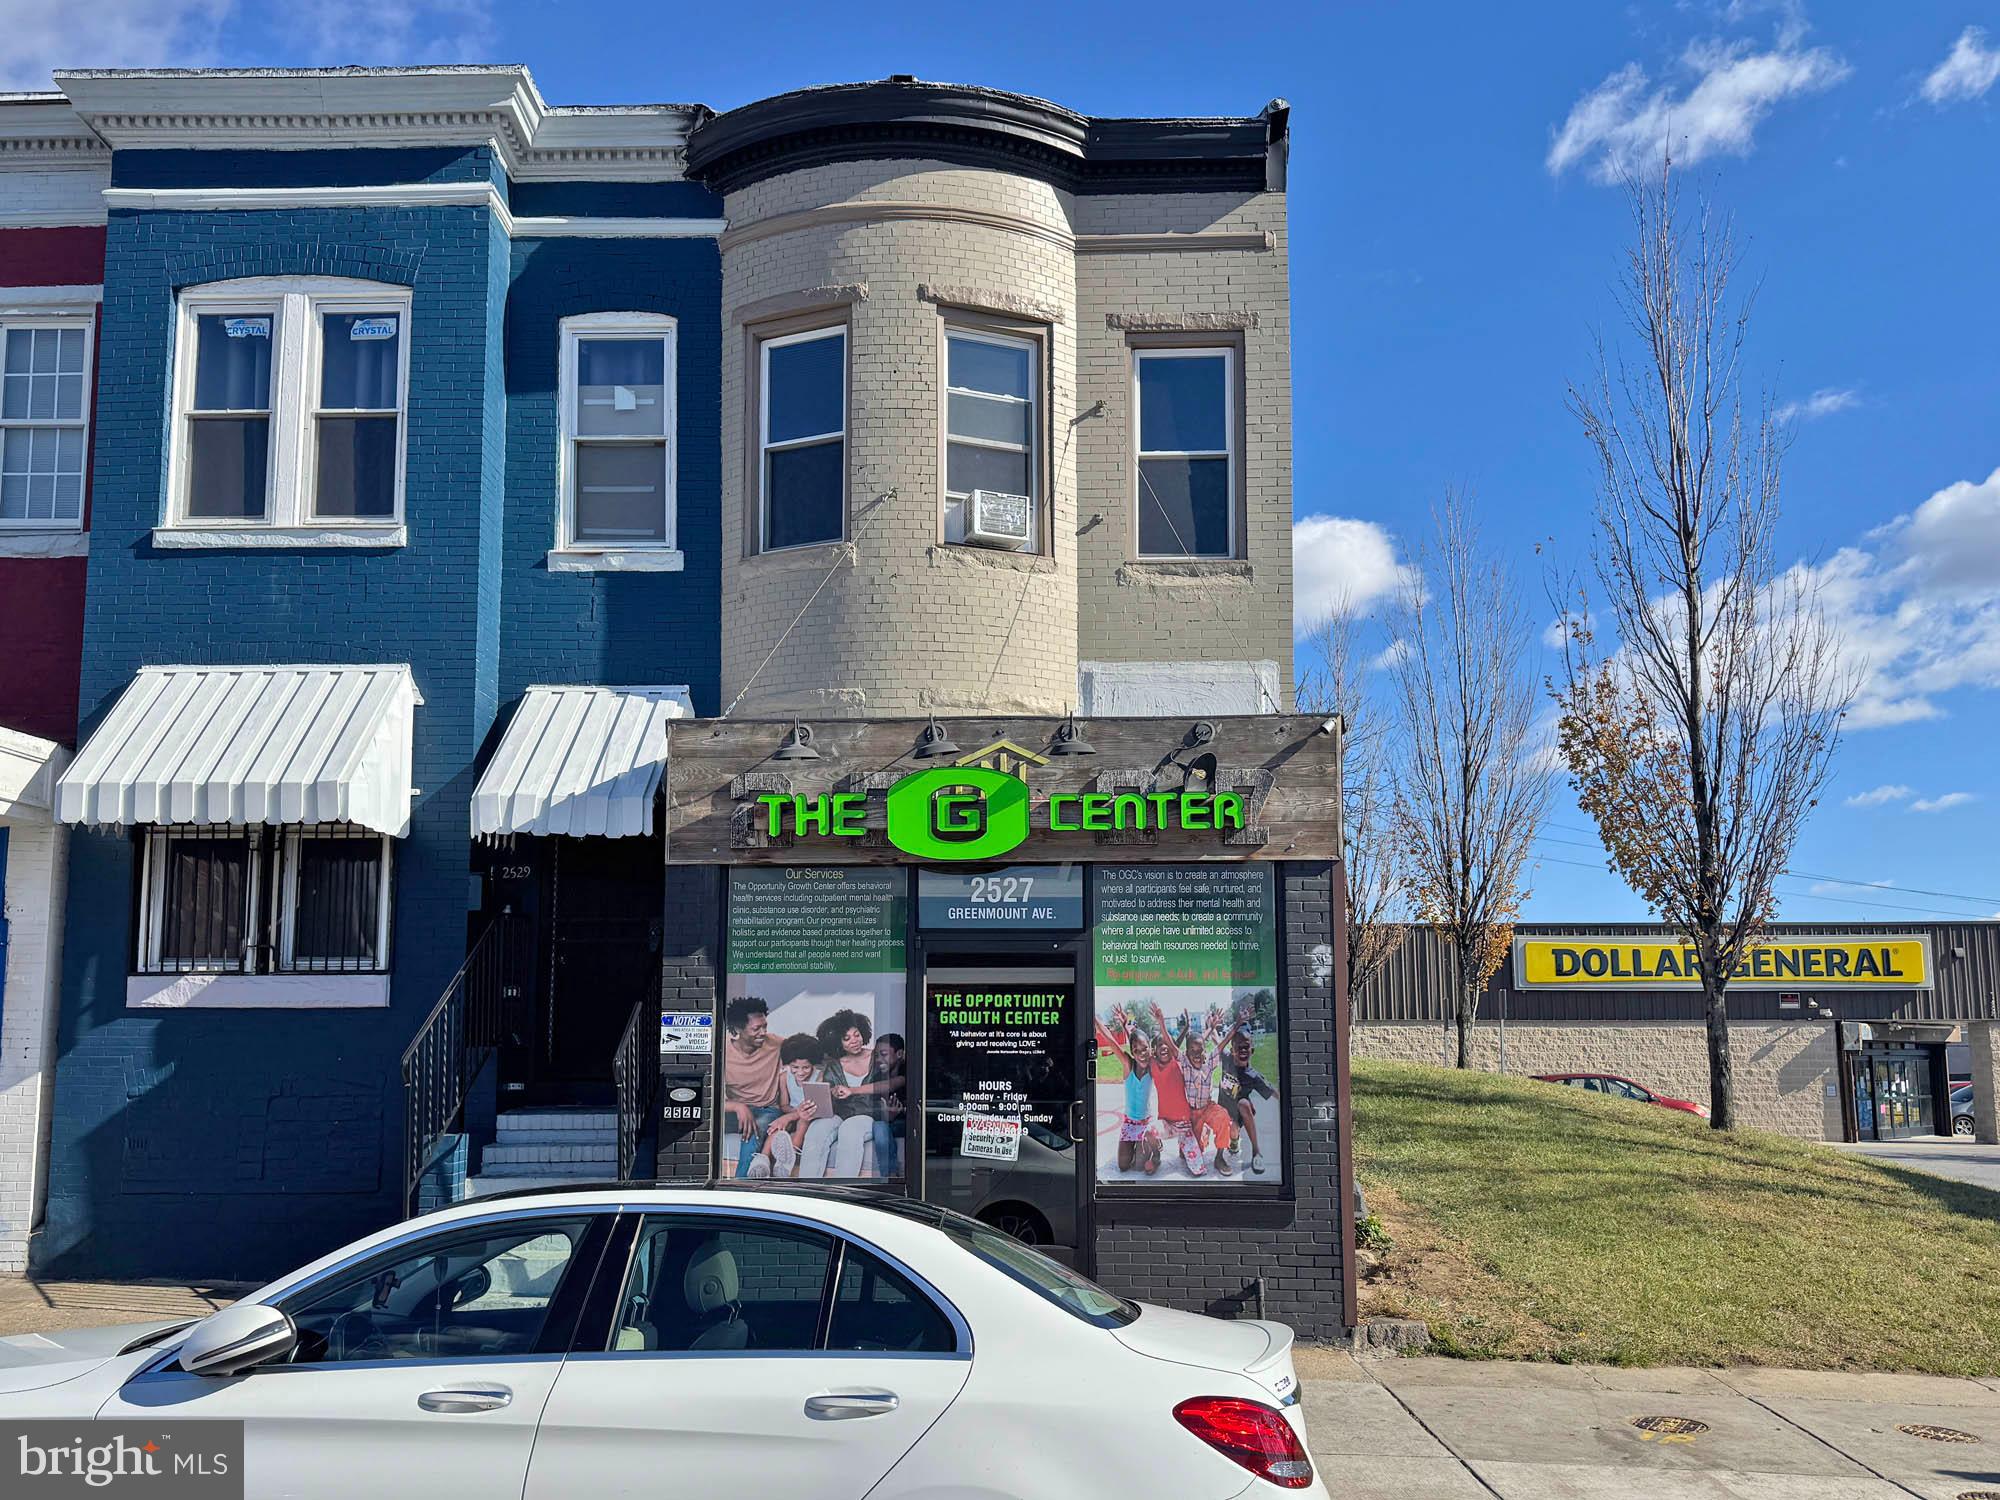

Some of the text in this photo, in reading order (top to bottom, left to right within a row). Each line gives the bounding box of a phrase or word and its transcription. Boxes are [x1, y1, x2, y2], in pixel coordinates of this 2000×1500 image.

[227, 326, 267, 335] CRYSTAL
[352, 326, 393, 335] CRYSTAL
[757, 793, 866, 837] THE
[1049, 791, 1245, 831] CENTER
[502, 866, 531, 879] 2529
[786, 868, 844, 879] Our Services
[1102, 870, 1264, 880] The OGC's vision is to create an atmosphere
[733, 882, 892, 892] The Opportunity Growth Center offers behavioral
[970, 877, 1034, 903] 2527
[1101, 884, 1262, 894] where all participants feel safe, nurtured, and
[732, 894, 894, 903] health services including outpatient mental health
[1102, 898, 1261, 908] motivated to address their mental health and
[752, 906, 786, 914] substance
[787, 906, 799, 914] use
[831, 906, 844, 914] and
[845, 906, 880, 915] psychiatric
[948, 908, 1057, 919] GREENMOUNT AVE.
[732, 916, 775, 924] rehabilitation
[806, 916, 819, 924] Our
[821, 916, 852, 926] programs
[854, 916, 877, 924] utilizes
[1101, 912, 1138, 921] substance
[1140, 912, 1154, 921] use
[1182, 912, 1189, 921] to
[1191, 912, 1214, 921] create
[1216, 912, 1221, 921] a
[1223, 912, 1263, 923] community
[732, 928, 891, 937] holistic and evidence based practices together to
[1102, 925, 1252, 937] where all people have unlimited access to
[732, 939, 757, 948] support
[771, 939, 809, 948] participants
[852, 939, 876, 948] healing
[1102, 940, 1138, 950] behavioral
[1140, 940, 1161, 950] health
[1163, 940, 1199, 950] resources
[1201, 940, 1227, 950] needed
[1232, 940, 1238, 950] to
[732, 950, 881, 959] We understand that all people need and want
[1102, 954, 1114, 963] not
[1115, 954, 1128, 965] just
[1131, 954, 1138, 963] to
[732, 962, 760, 971] physical
[761, 962, 775, 970] and
[776, 962, 808, 970] emotional
[1551, 948, 1702, 978] DOLLAR
[934, 994, 1065, 1007] THE OPPORTUNITY
[672, 1015, 701, 1026] NOTICE
[940, 1011, 1059, 1024] GROWTH CENTER
[956, 1040, 974, 1048] giving
[989, 1040, 1017, 1048] receiving
[978, 1081, 1012, 1091] HOURS
[962, 1092, 994, 1102] Monday
[1003, 1092, 1028, 1102] Friday
[959, 1103, 989, 1111] 9:00am
[999, 1103, 1017, 1111] 9:00
[664, 1107, 701, 1119] 2527
[938, 1114, 965, 1122] Closed
[1024, 1114, 1053, 1123] Sunday
[969, 1133, 994, 1144] Security
[968, 1143, 993, 1153] Cameras
